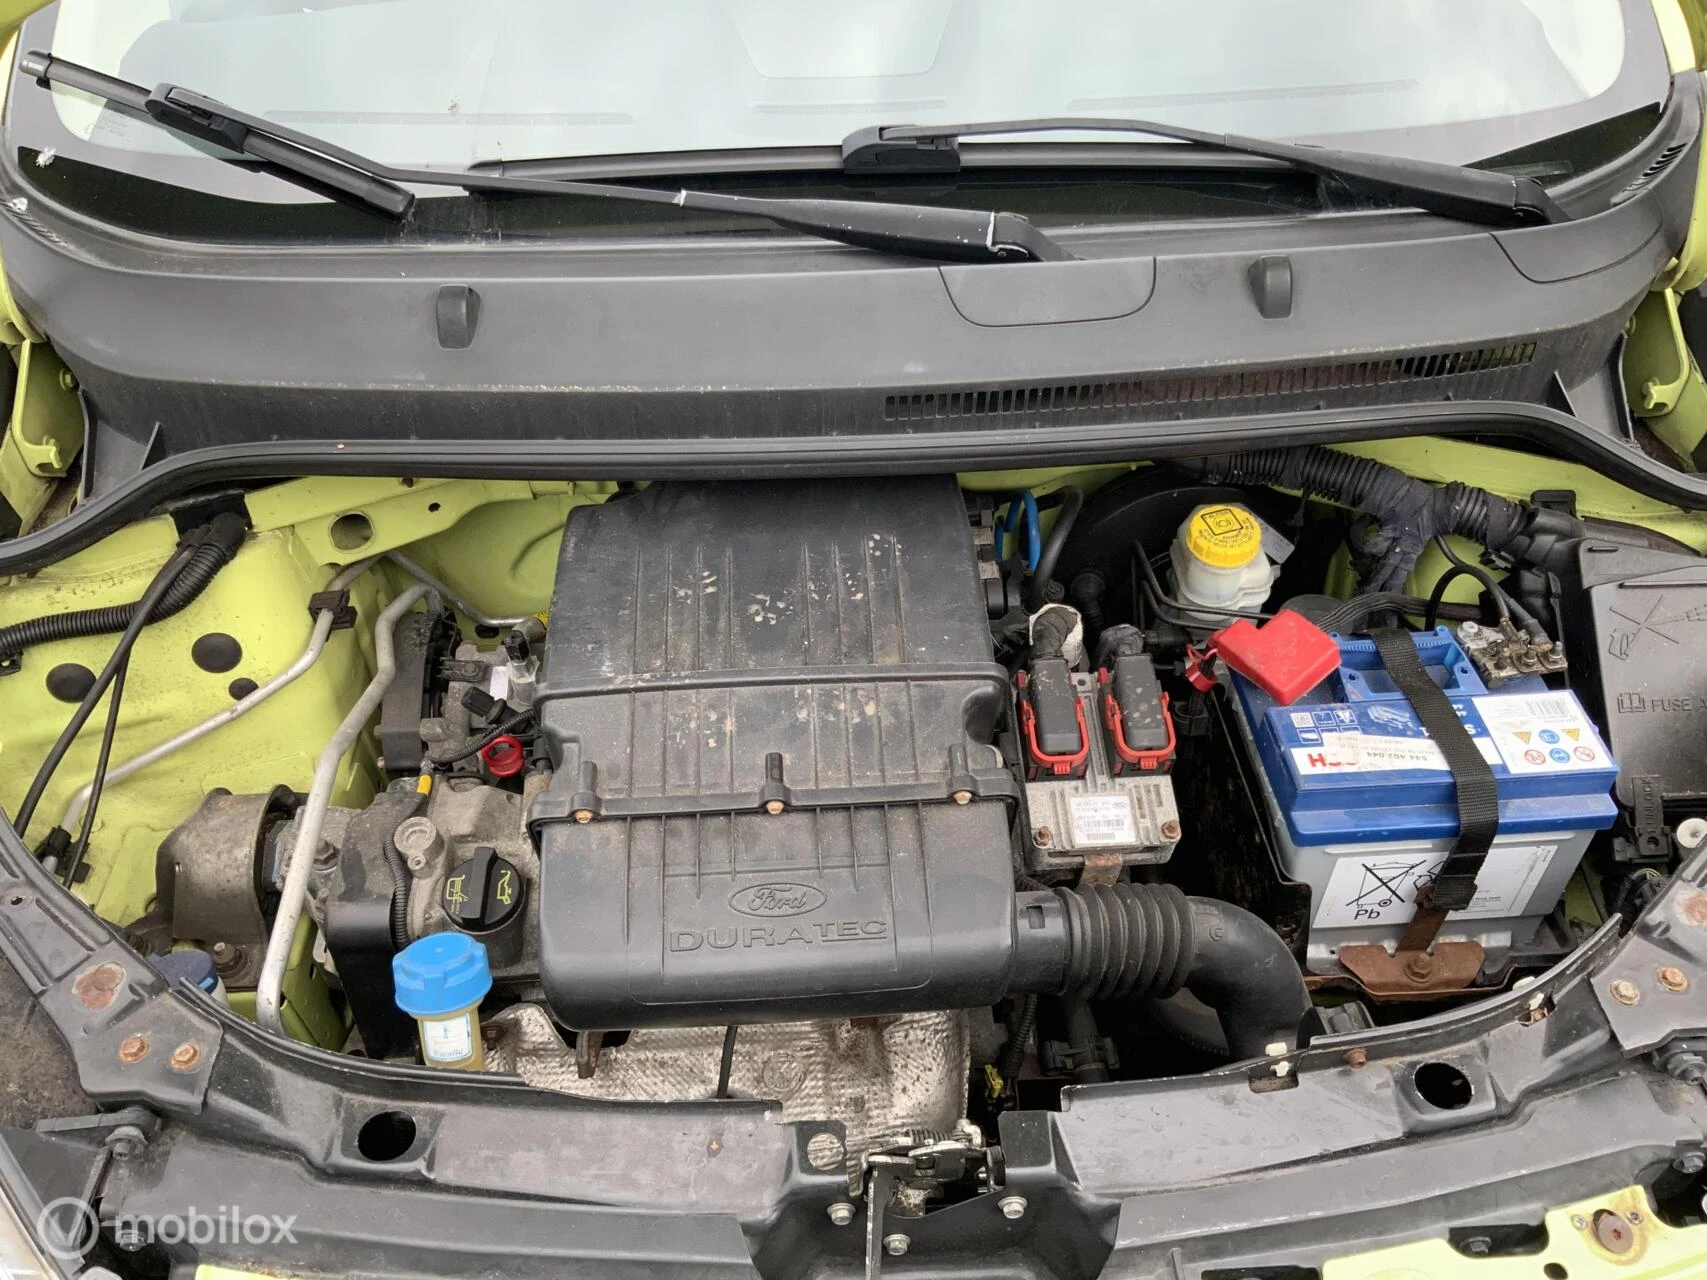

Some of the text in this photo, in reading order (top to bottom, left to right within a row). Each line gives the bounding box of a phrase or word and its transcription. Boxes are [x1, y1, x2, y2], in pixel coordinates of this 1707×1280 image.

[1651, 698, 1693, 713] FUSE
[747, 886, 808, 911] Ford
[1354, 909, 1381, 920] Pb
[669, 920, 888, 952] DURATEC
